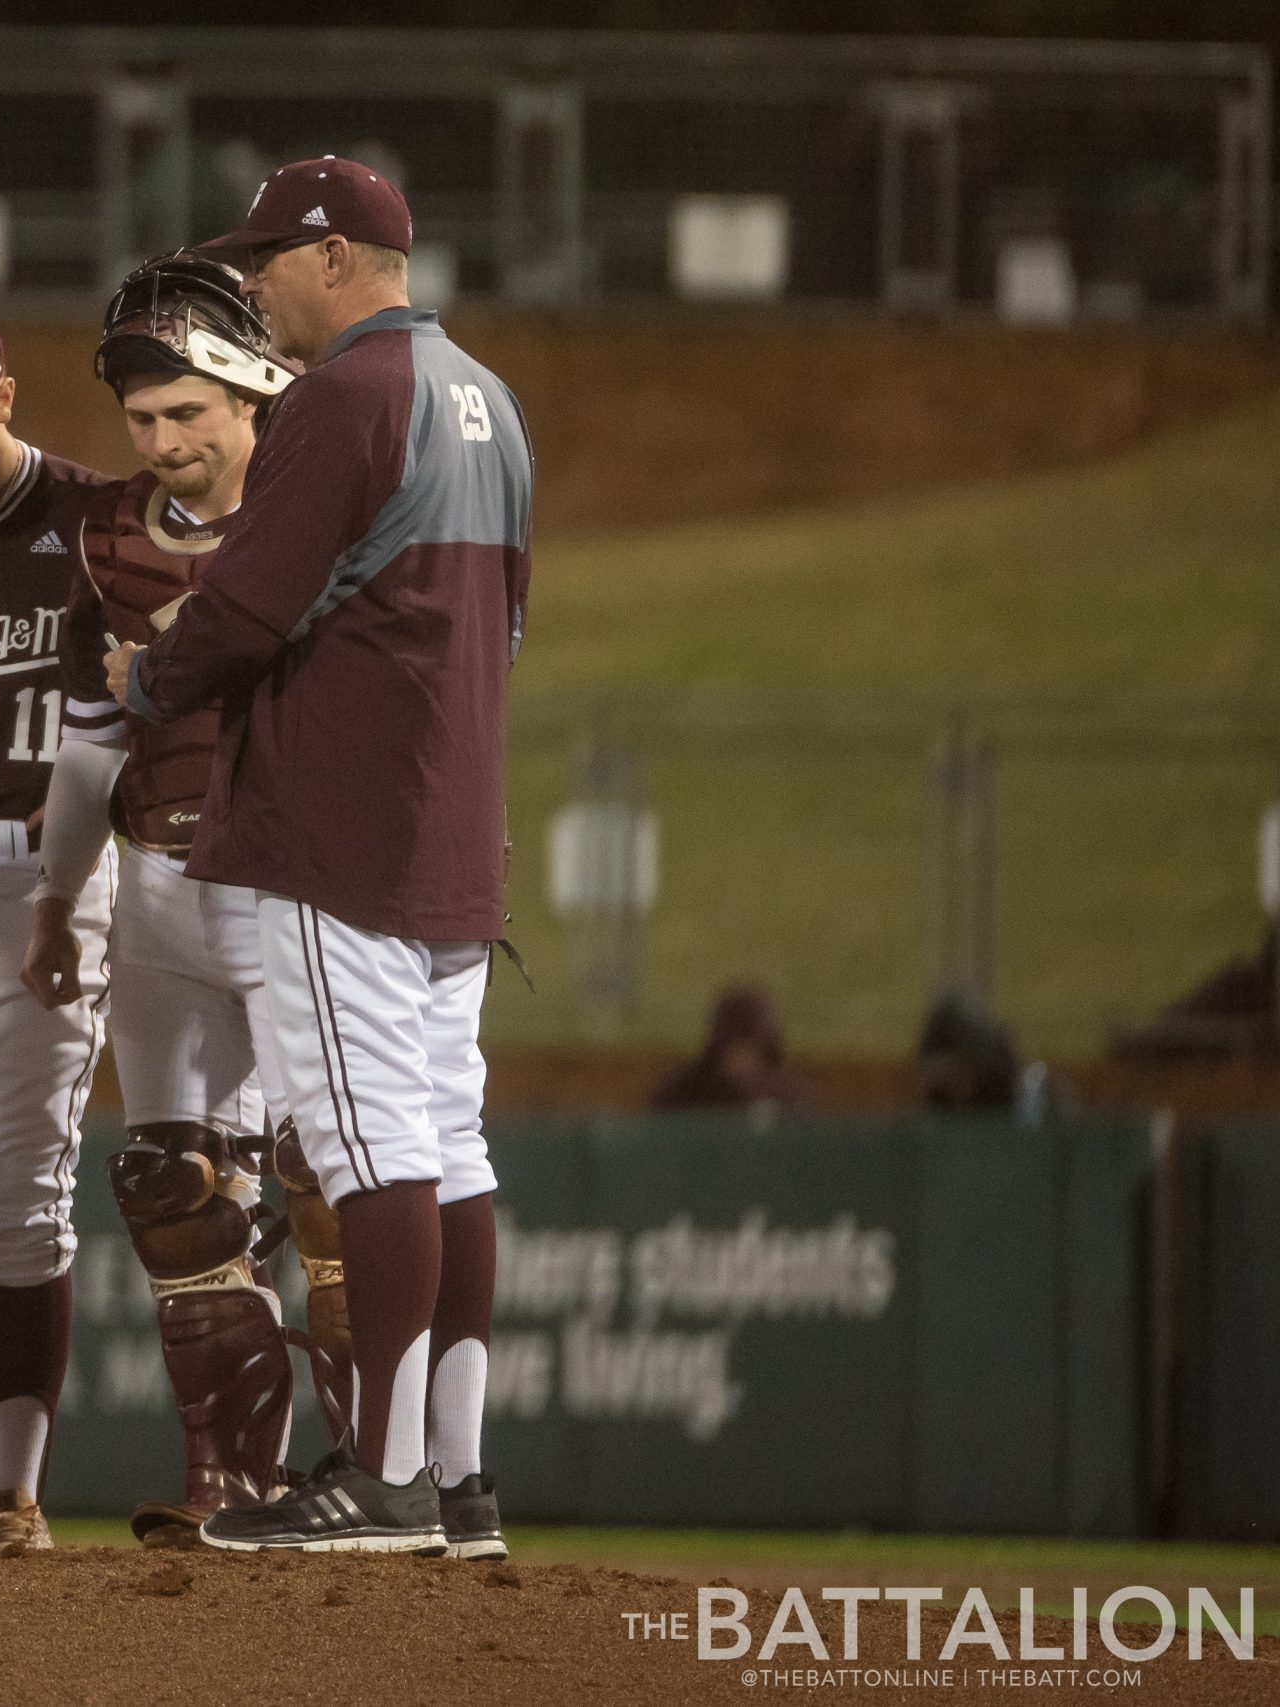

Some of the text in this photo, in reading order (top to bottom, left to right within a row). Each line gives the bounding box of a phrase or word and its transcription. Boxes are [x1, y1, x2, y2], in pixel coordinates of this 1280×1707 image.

[301, 217, 330, 228] adidas
[449, 384, 493, 442] 29
[184, 530, 214, 541] AGGIES
[30, 542, 68, 555] adidas
[8, 686, 62, 763] 11
